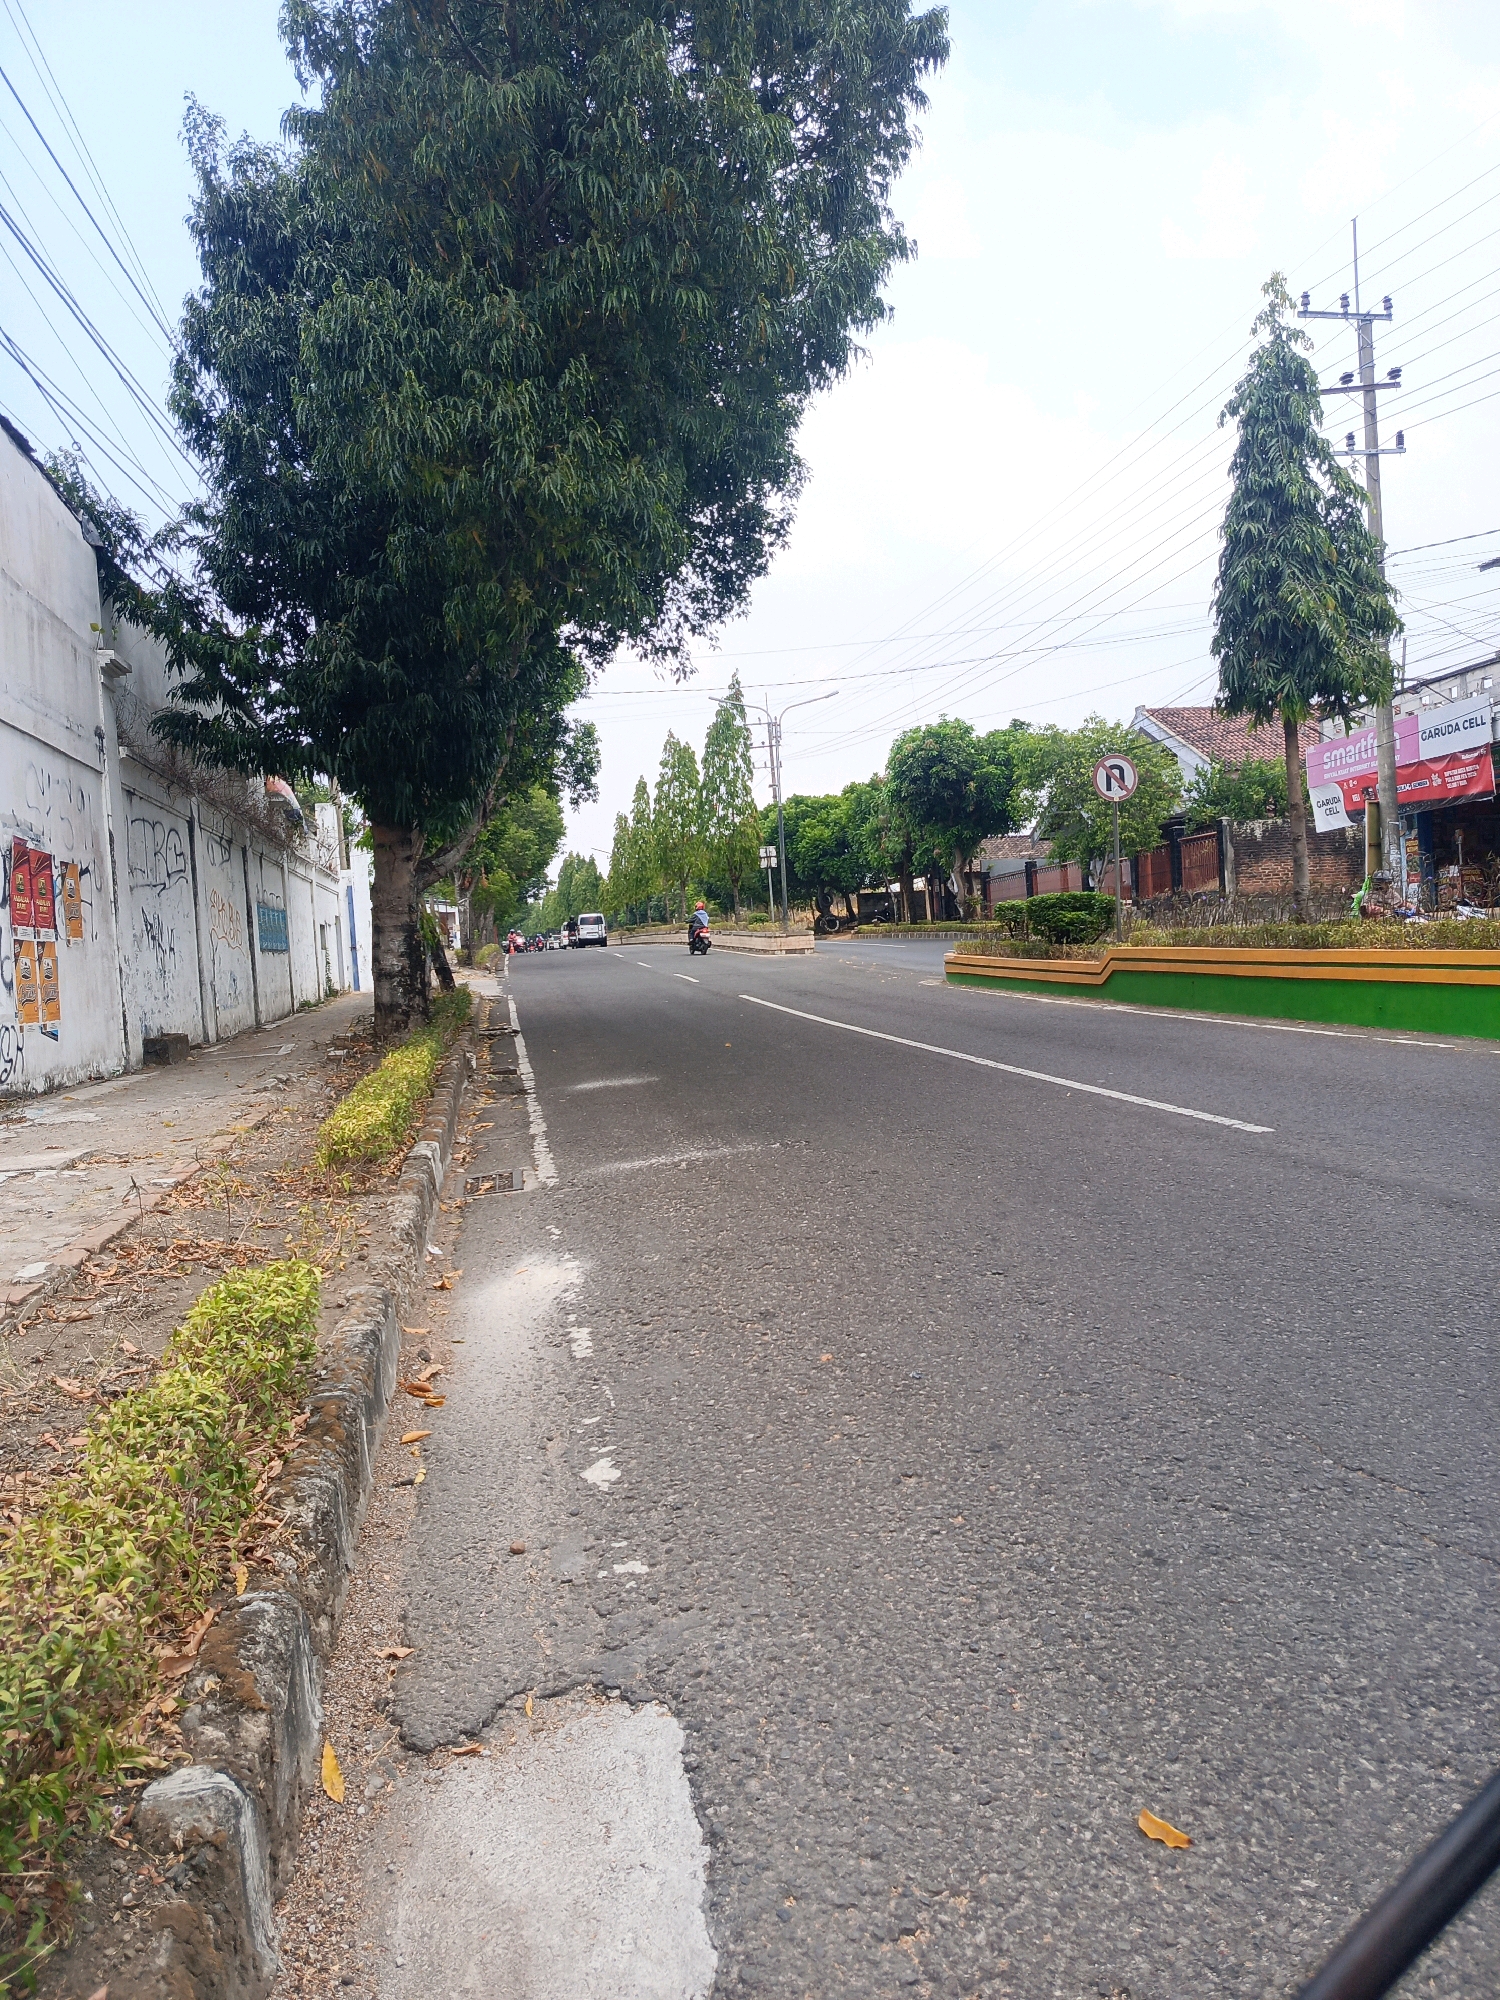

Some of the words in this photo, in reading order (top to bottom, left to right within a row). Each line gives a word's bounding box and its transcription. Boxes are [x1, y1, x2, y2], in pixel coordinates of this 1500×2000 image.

[1421, 721, 1461, 741] GARUDA
[1462, 714, 1487, 731] CELL
[1316, 795, 1341, 808] GARUDA
[1324, 805, 1340, 816] CELL
